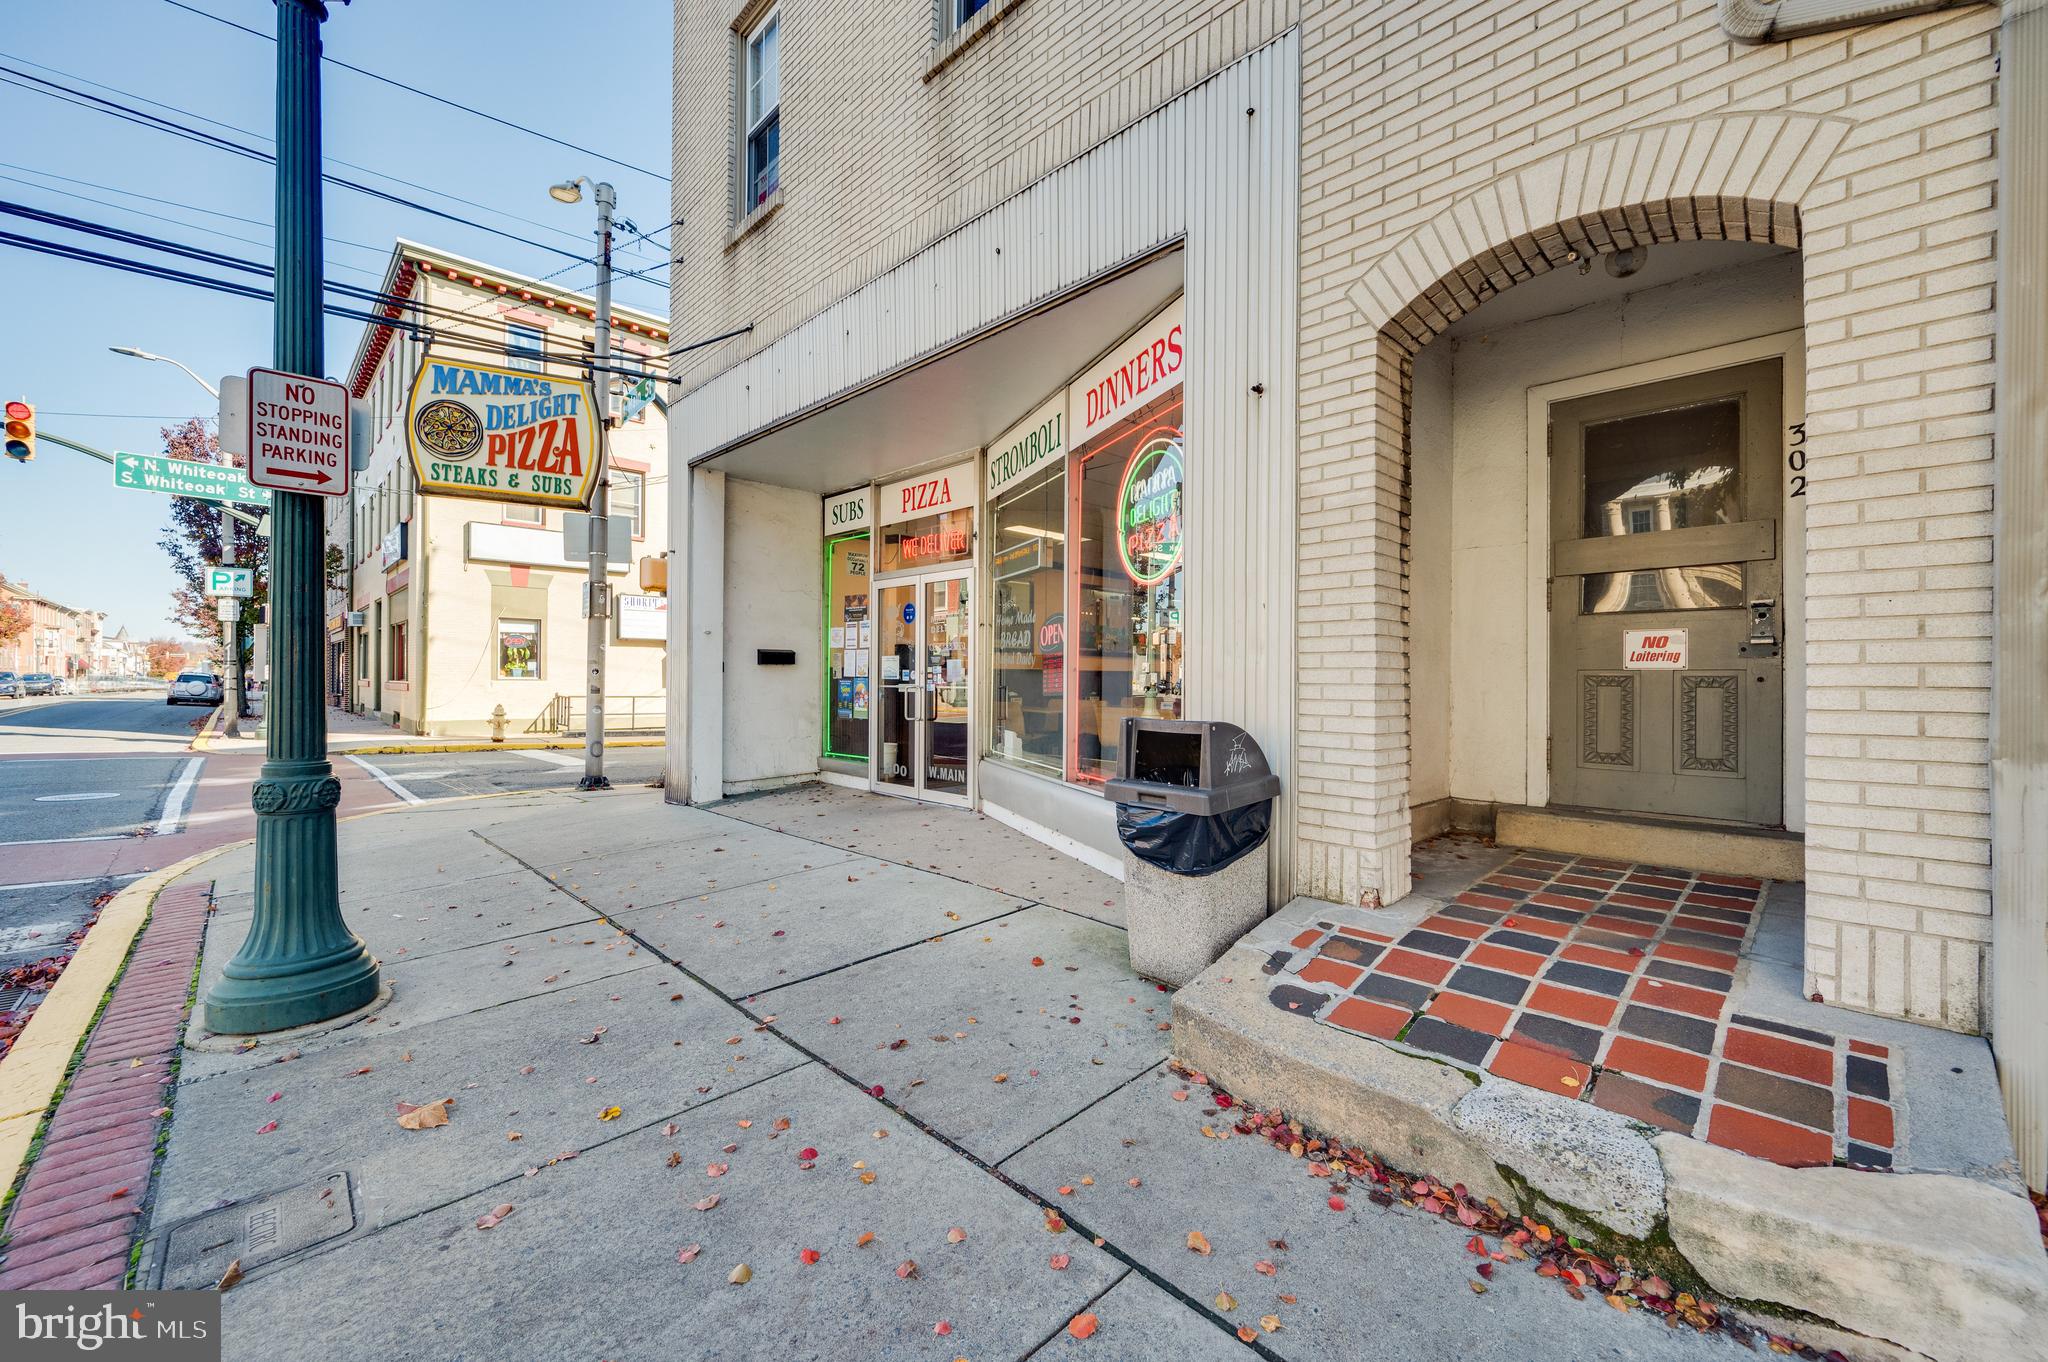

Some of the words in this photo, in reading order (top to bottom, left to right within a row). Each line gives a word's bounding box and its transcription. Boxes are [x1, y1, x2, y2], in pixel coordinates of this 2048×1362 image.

[431, 364, 552, 397] MAMMA'S
[1086, 324, 1183, 428] DINNERS
[286, 383, 315, 405] NO
[257, 402, 342, 429] STOPPING
[485, 393, 581, 430] DELIGHT
[257, 422, 342, 449] STANDING
[486, 417, 583, 477] PIZZA
[262, 443, 337, 468] PARKING
[990, 412, 1062, 490] STROMBOLI
[1788, 422, 1806, 498] 302
[121, 471, 137, 484] S.
[144, 473, 225, 496] Whiteoak
[238, 486, 256, 499] St
[143, 459, 160, 472] N.
[167, 461, 246, 484] Whiteoak
[431, 462, 498, 488] STEAKS
[508, 473, 519, 488] &
[532, 474, 572, 496] SUBS
[902, 477, 952, 514] PIZZA
[832, 498, 864, 526] SUBS
[902, 537, 919, 559] WE
[920, 528, 966, 556] DELIVER
[851, 562, 865, 572] 72
[1001, 629, 1031, 650] BREAD
[1040, 623, 1065, 646] OPEN
[1641, 635, 1669, 649] NO
[1629, 650, 1681, 663] Loitering
